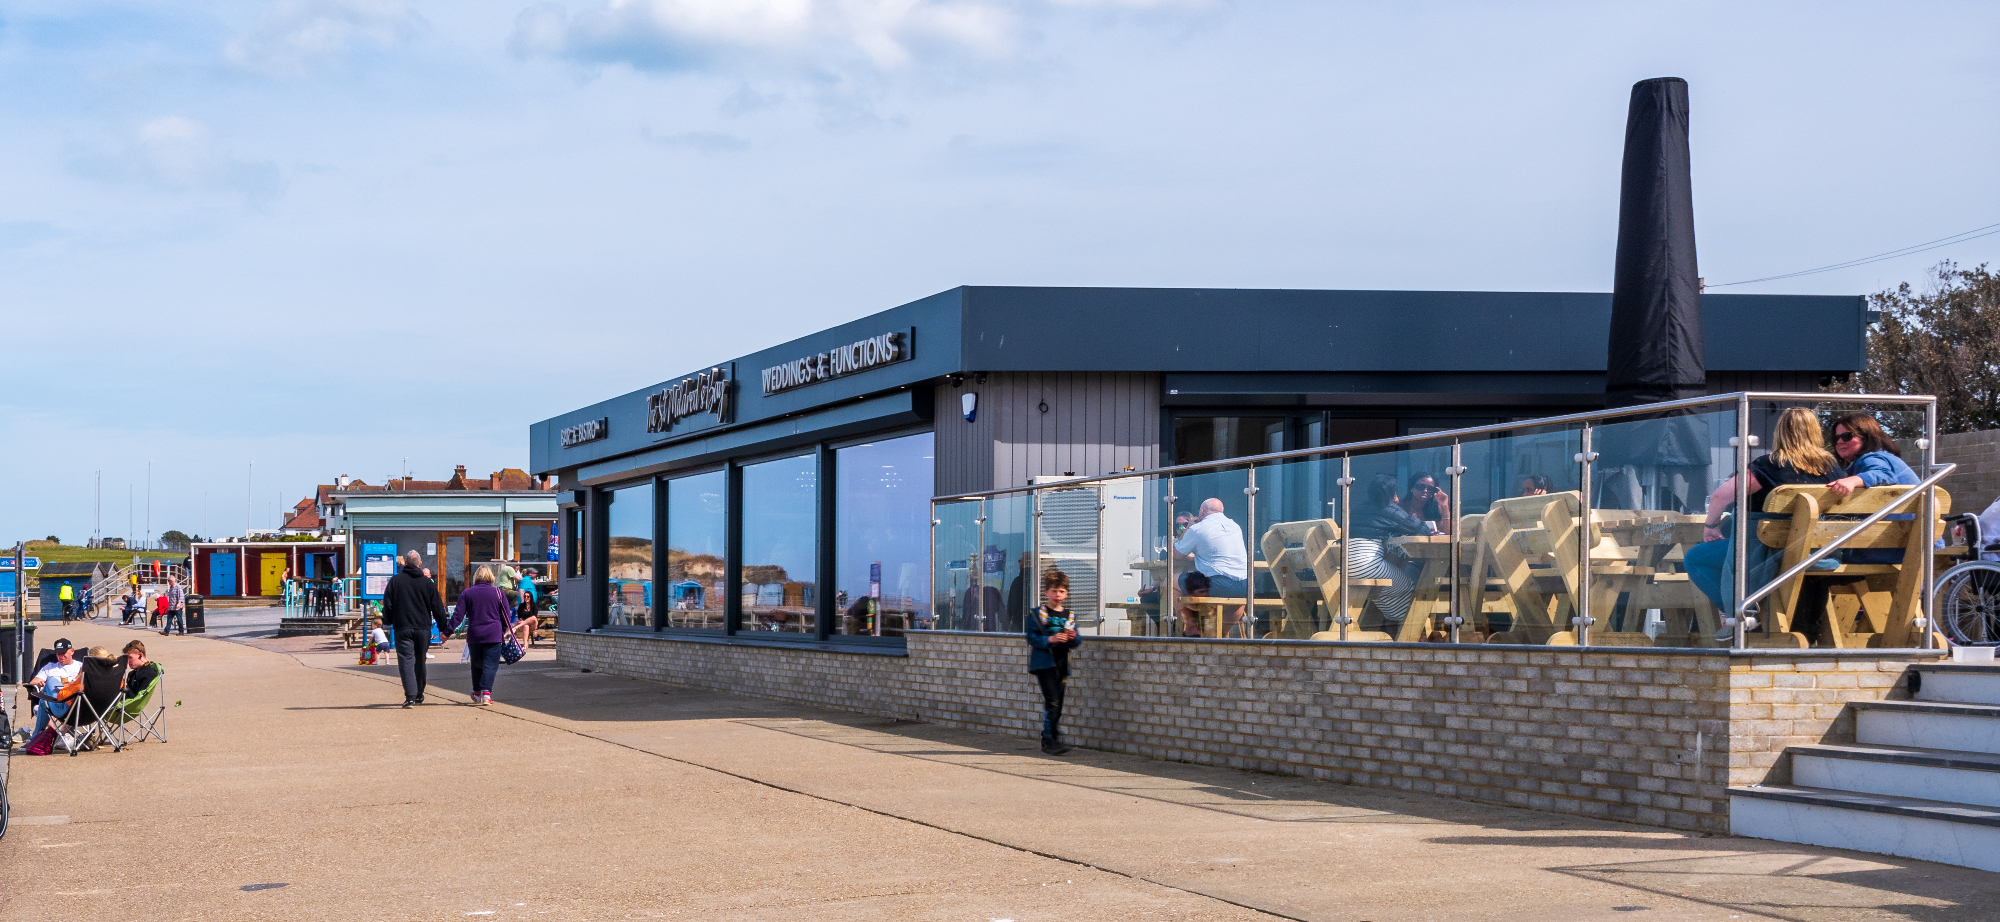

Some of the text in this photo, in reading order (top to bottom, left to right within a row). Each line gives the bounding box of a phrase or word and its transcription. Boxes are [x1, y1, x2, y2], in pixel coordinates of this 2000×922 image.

[761, 332, 894, 394] WEDDINGS & FUNCTIONS
[560, 428, 571, 447] BAR
[579, 419, 596, 442] BISTRO
